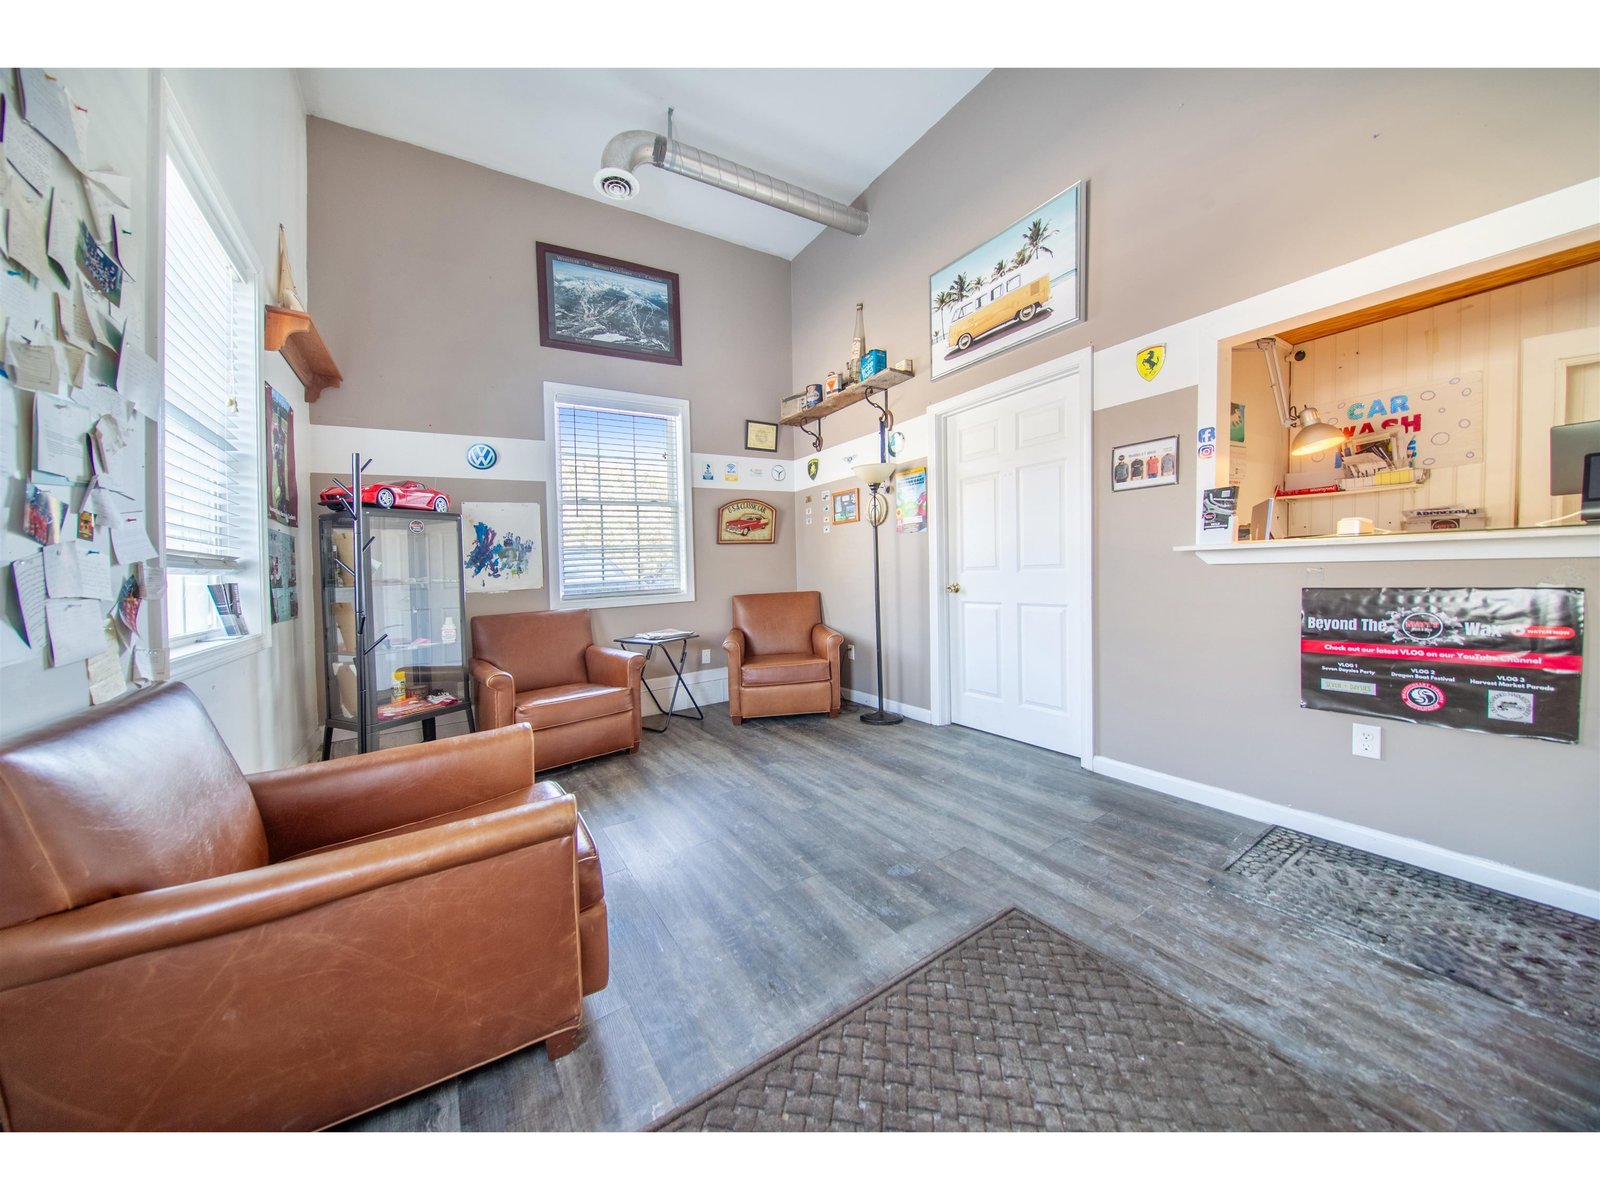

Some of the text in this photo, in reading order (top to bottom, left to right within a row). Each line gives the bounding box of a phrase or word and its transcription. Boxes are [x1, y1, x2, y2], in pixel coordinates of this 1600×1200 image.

[1347, 394, 1410, 421] CAR
[1307, 616, 1388, 632] Beyond The
[1464, 621, 1503, 638] Wax
[1324, 643, 1346, 652] Check
[1376, 647, 1399, 655] latest
[1400, 648, 1425, 657] VLOG
[1456, 652, 1498, 662] YouTube
[1499, 655, 1542, 665] Channel
[1359, 668, 1376, 676] Party
[1391, 671, 1414, 679] Dragon
[1469, 678, 1555, 691] Harvest Market Parade
